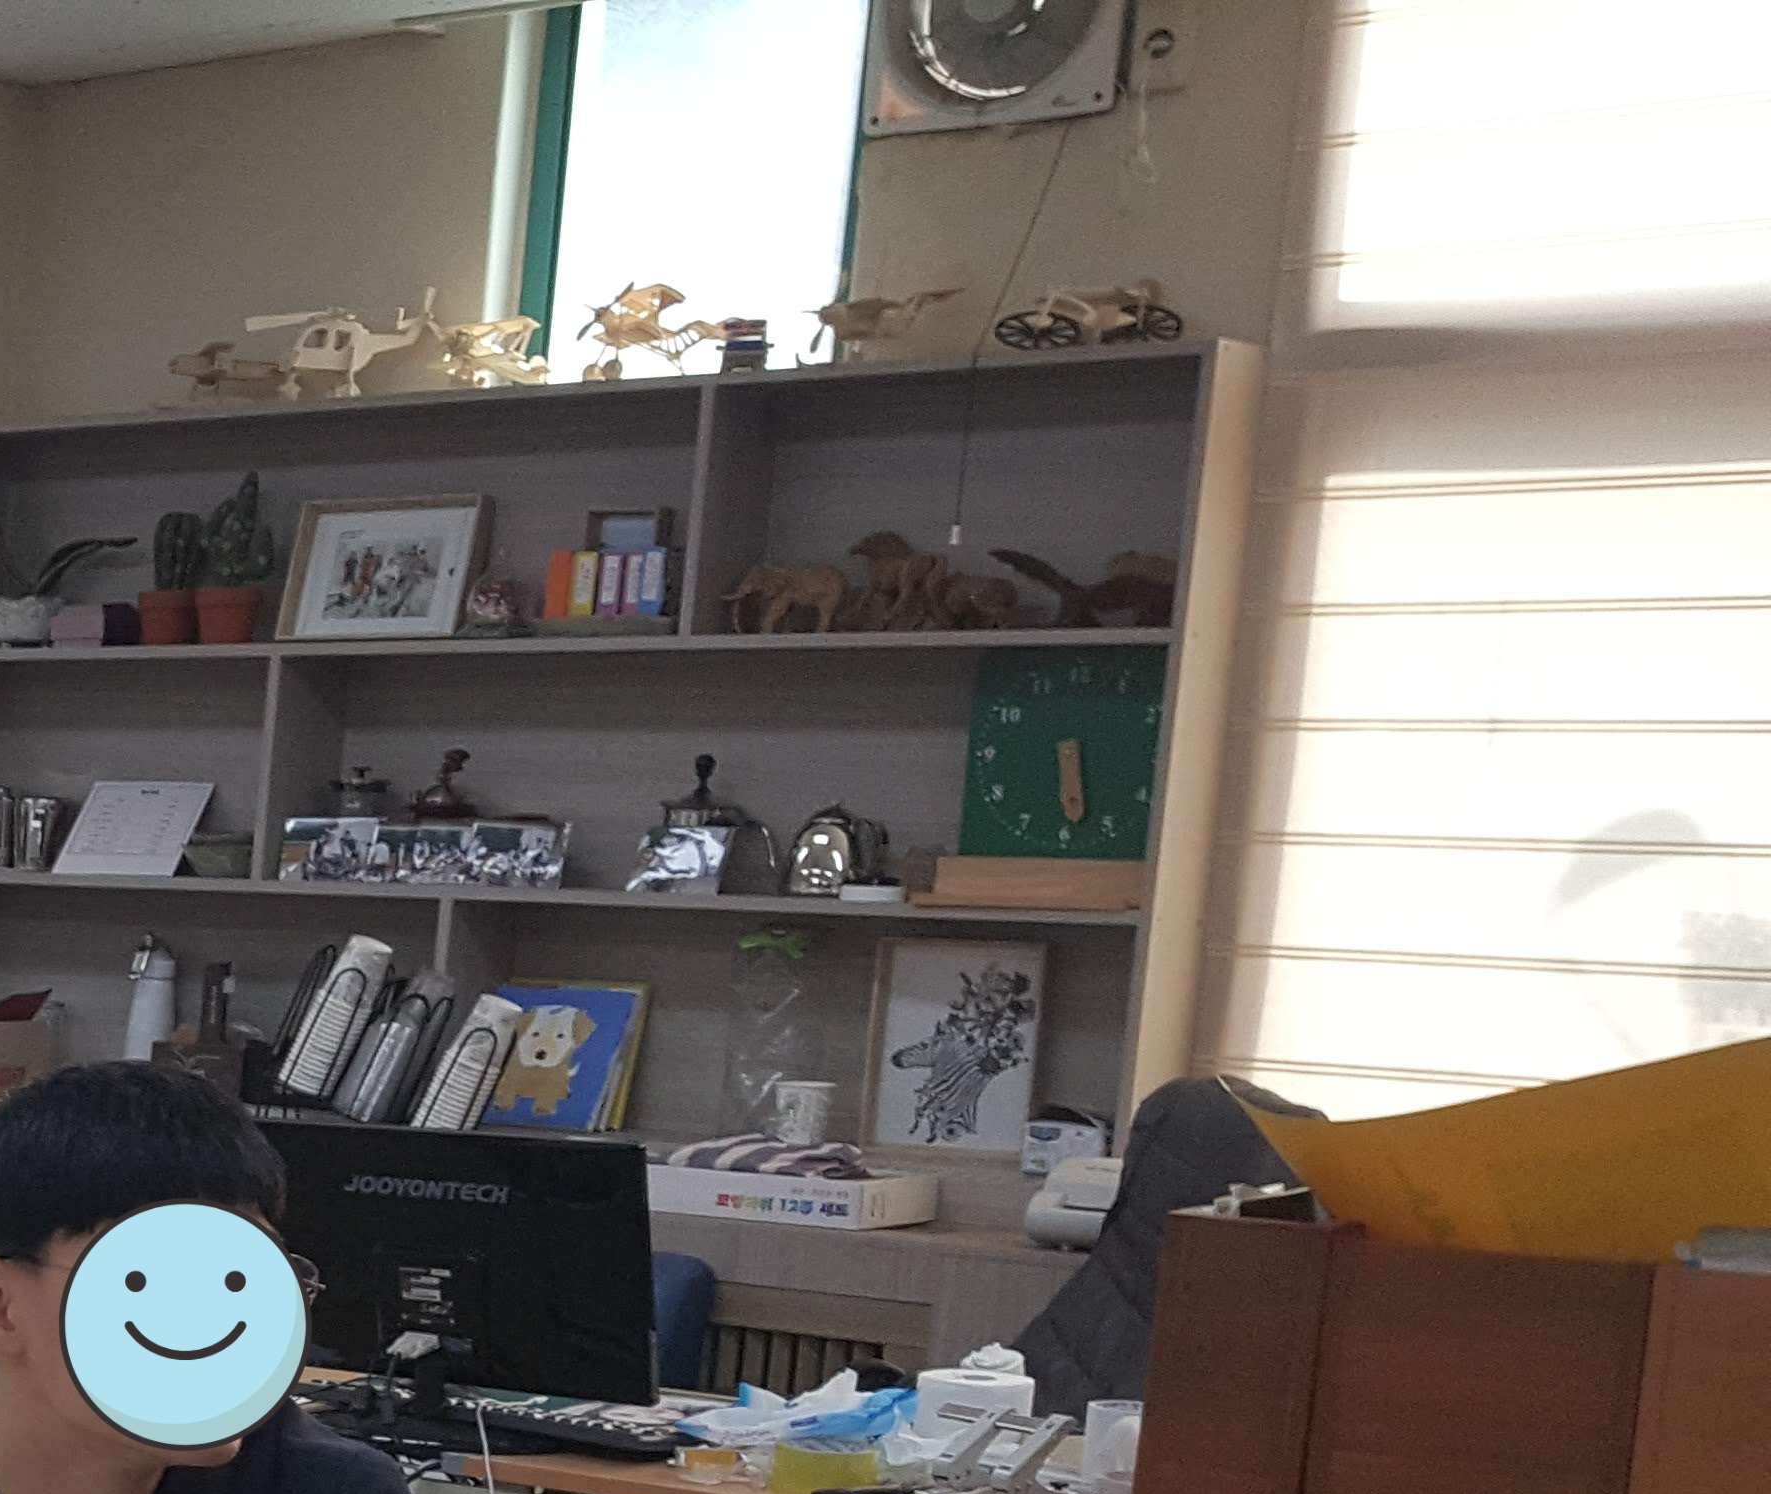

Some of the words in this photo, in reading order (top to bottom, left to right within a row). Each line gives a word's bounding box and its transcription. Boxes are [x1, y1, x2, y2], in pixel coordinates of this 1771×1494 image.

[998, 706, 1022, 724] 10
[1018, 812, 1032, 831] 7
[343, 1174, 510, 1205] JOOYONTECH
